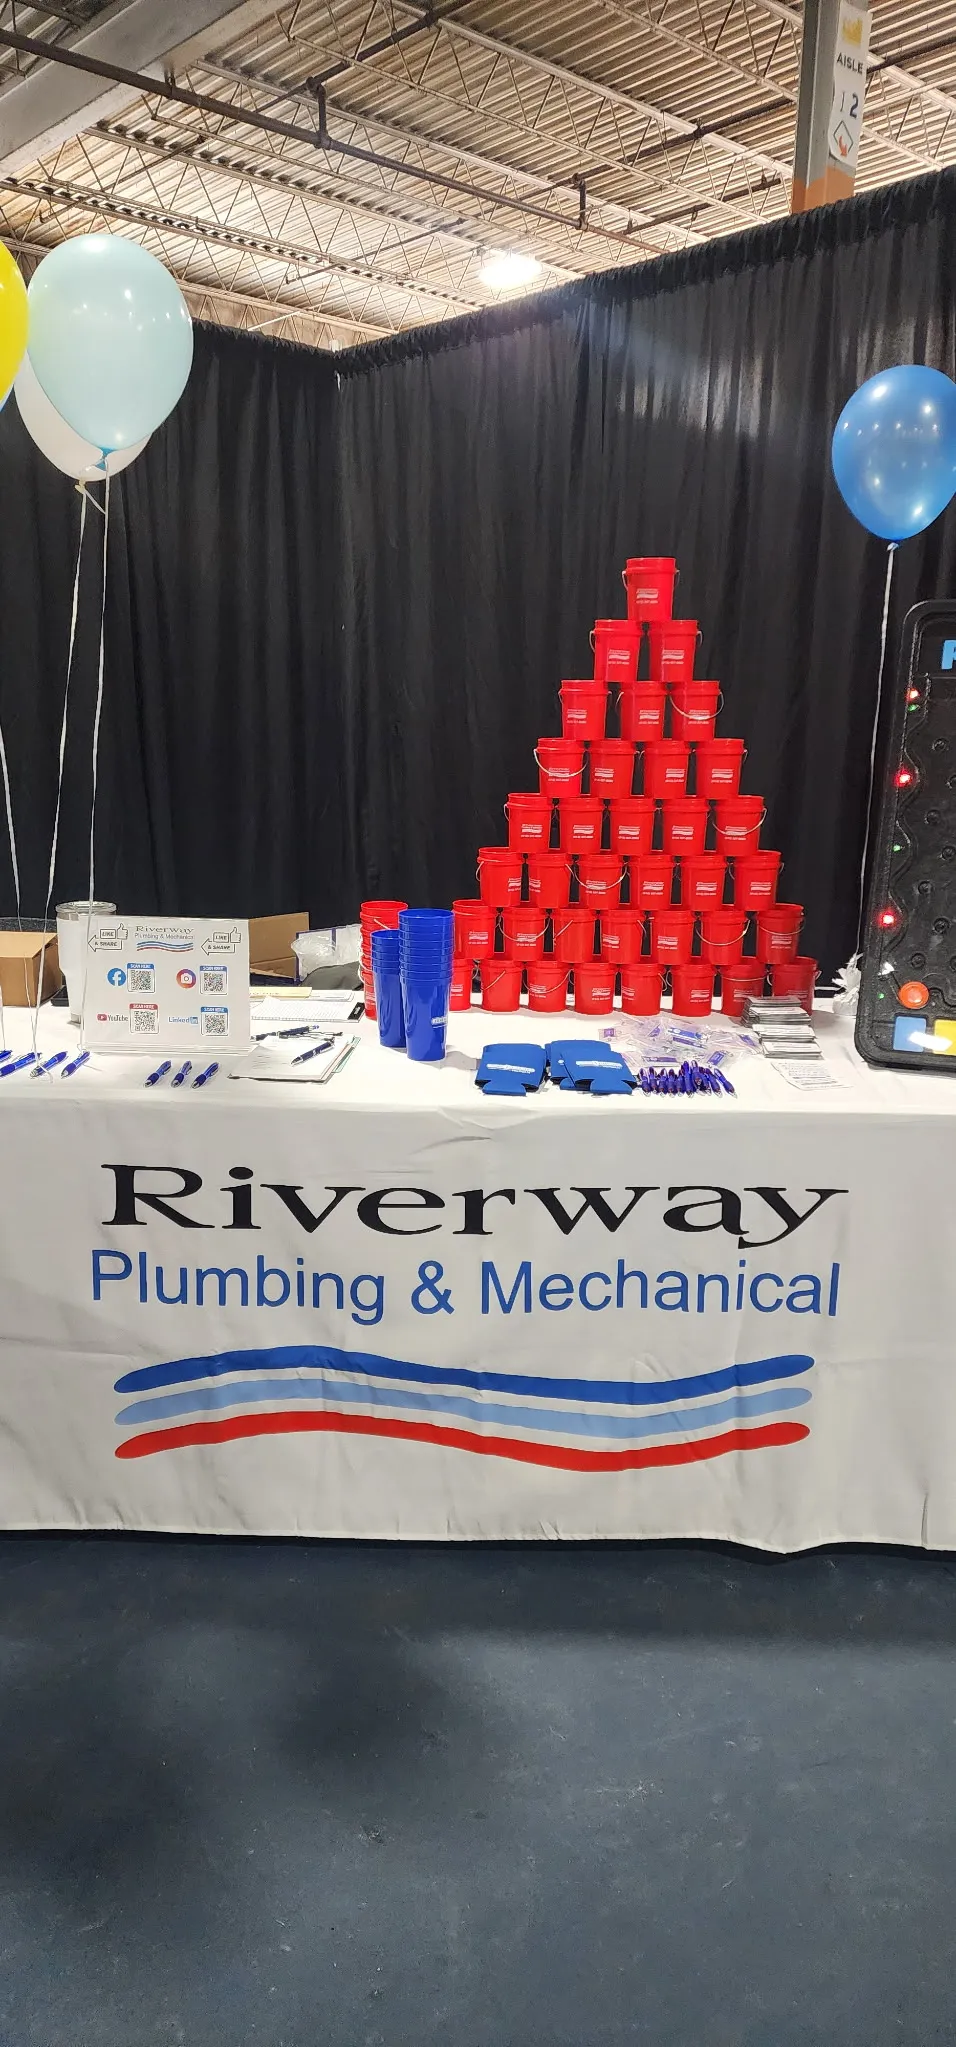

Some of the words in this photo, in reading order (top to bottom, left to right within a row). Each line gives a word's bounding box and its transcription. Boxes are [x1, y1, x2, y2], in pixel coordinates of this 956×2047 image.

[836, 52, 864, 75] AISLE
[135, 925, 194, 934] Riverway
[101, 1164, 848, 1249] Riverway
[93, 1250, 383, 1325] Plumbing
[412, 1261, 453, 1314] &
[482, 1260, 839, 1316] Mechanical
